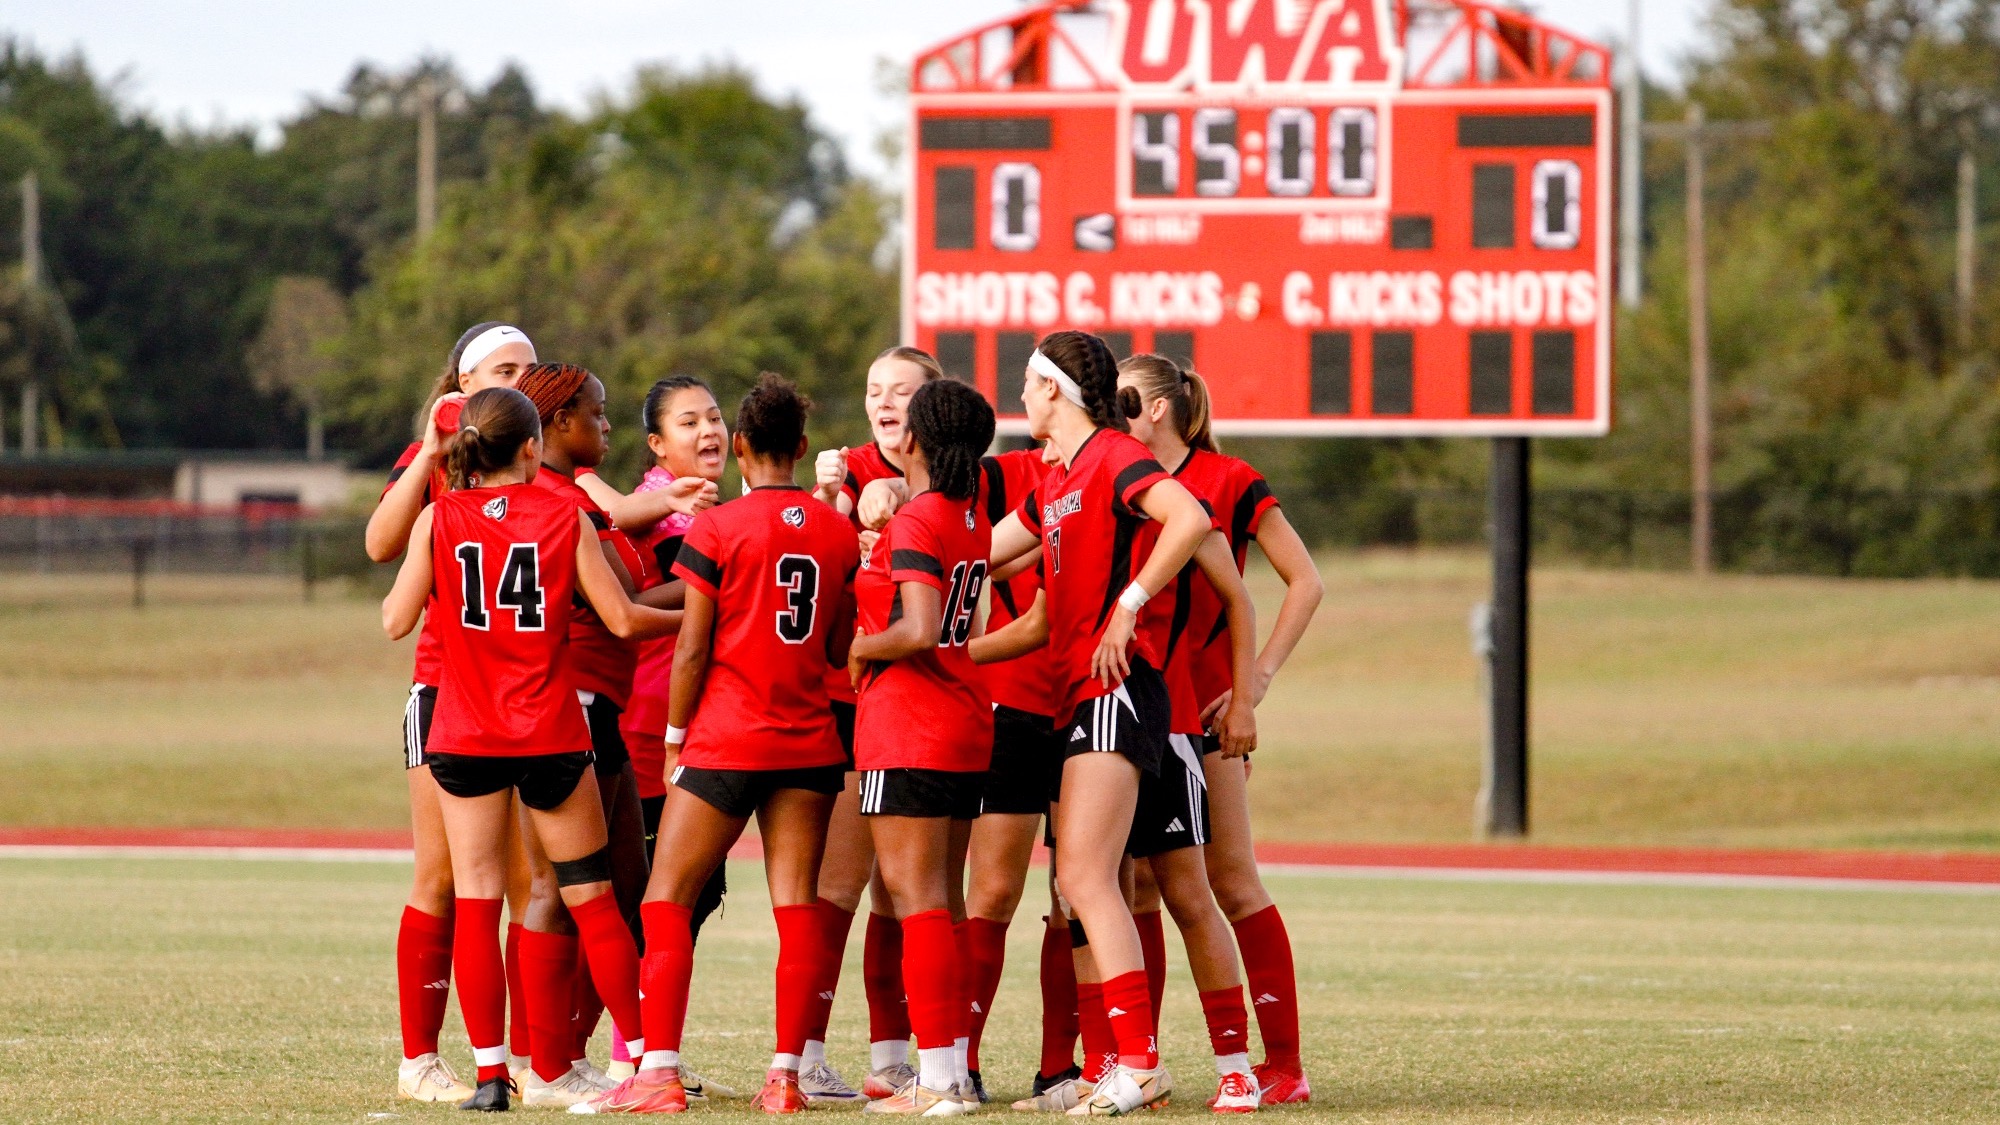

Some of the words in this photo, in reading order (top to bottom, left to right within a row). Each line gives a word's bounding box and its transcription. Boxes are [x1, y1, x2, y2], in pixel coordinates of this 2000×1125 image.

[1115, 0, 1399, 86] UWA
[1133, 107, 1377, 197] 45:00
[990, 162, 1041, 251] 0
[1531, 159, 1581, 249] 0
[918, 271, 1060, 326] SHOTS
[1064, 271, 1106, 326] C.
[1110, 271, 1224, 326] KICKS
[1282, 270, 1324, 326] C.
[1329, 270, 1443, 326] KICKS
[1449, 269, 1597, 326] SHOTS
[454, 541, 545, 632] 14
[776, 554, 820, 645] 3
[938, 559, 987, 647] 19
